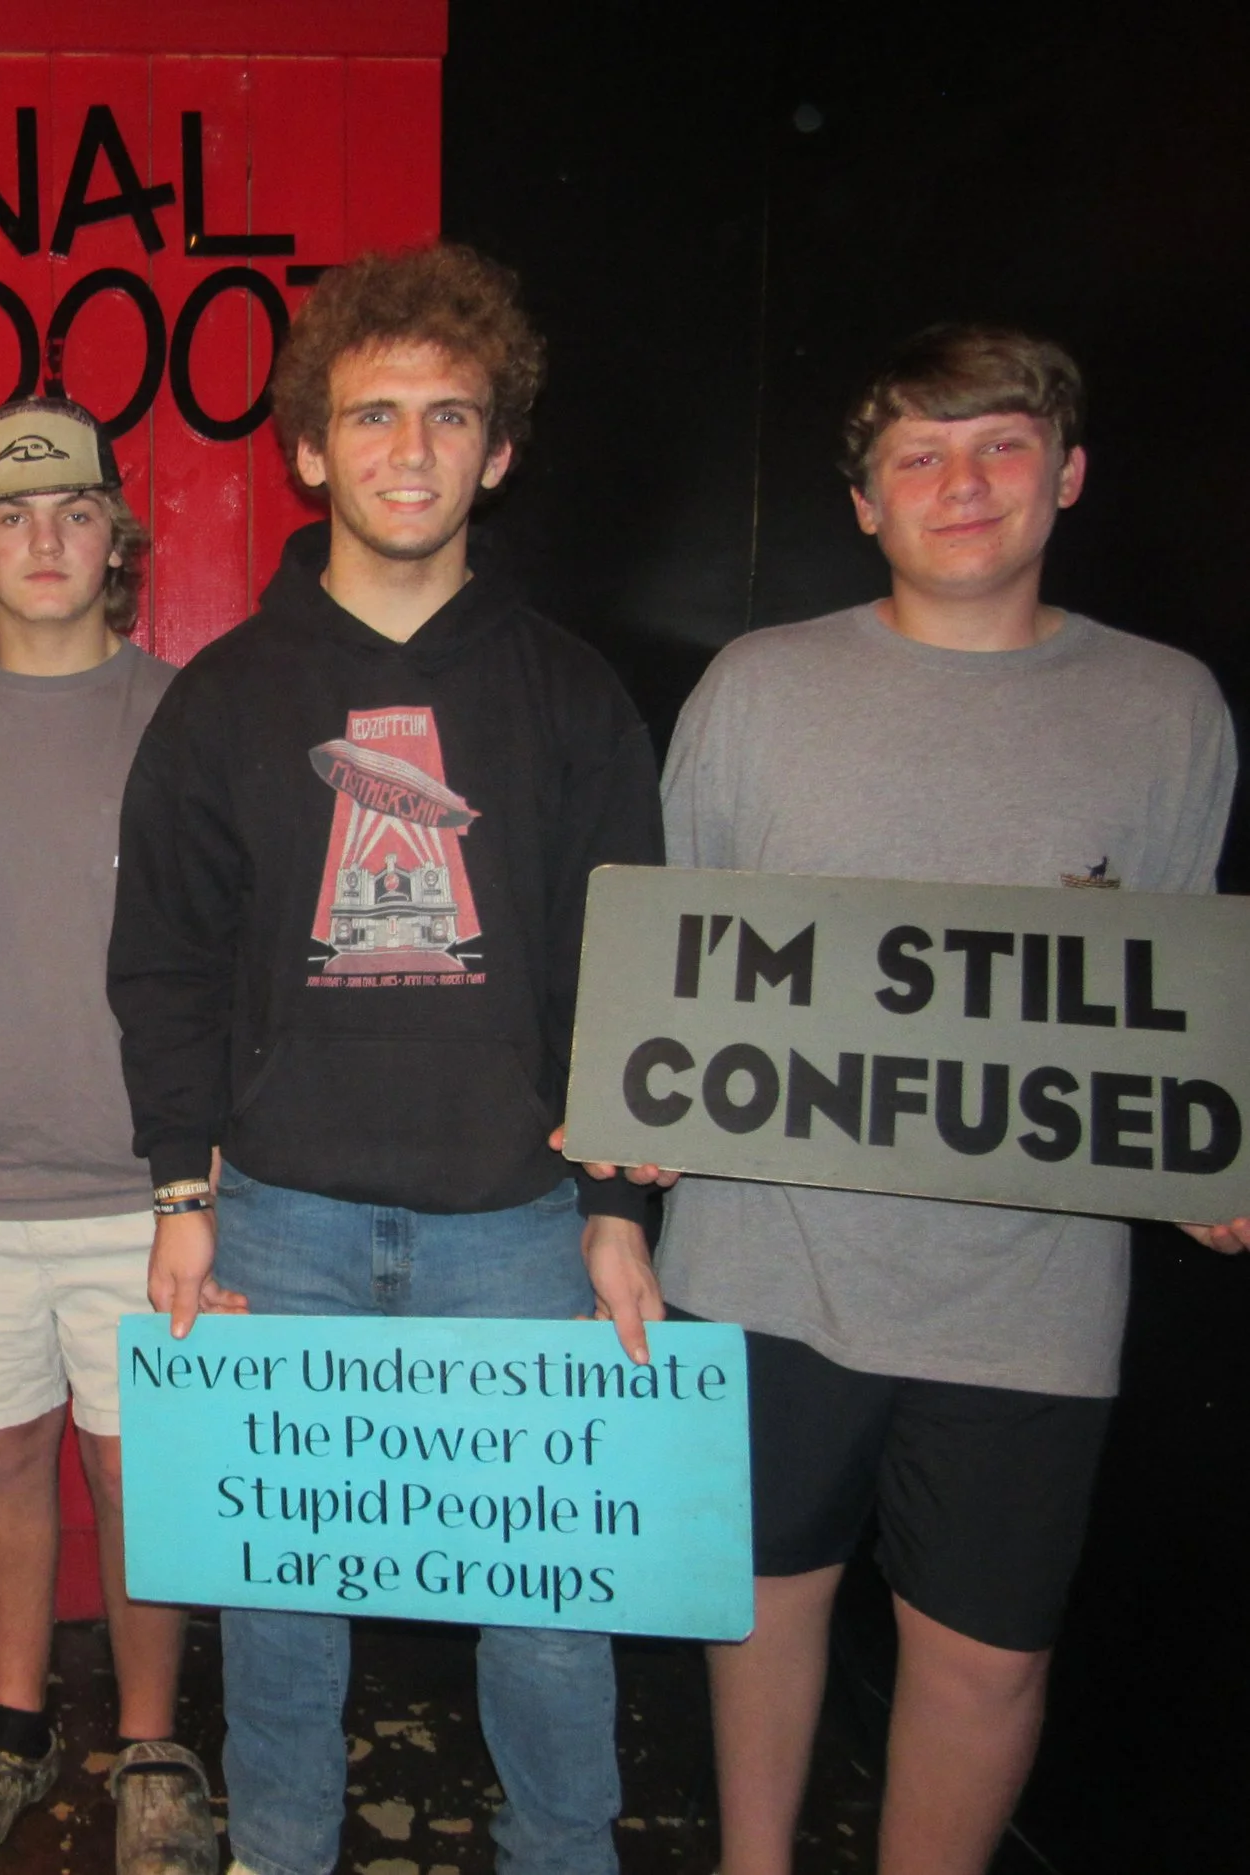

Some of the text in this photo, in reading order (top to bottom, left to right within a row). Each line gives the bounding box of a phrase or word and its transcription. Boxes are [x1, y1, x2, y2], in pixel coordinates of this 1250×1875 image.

[674, 913, 1187, 1032] I'M STILL
[622, 1037, 1243, 1176] CONFUSED
[132, 1346, 728, 1401] Never Underestimate
[244, 1412, 608, 1466] the Power of
[217, 1475, 641, 1543] Stupid People in
[243, 1541, 616, 1614] Large Groups
